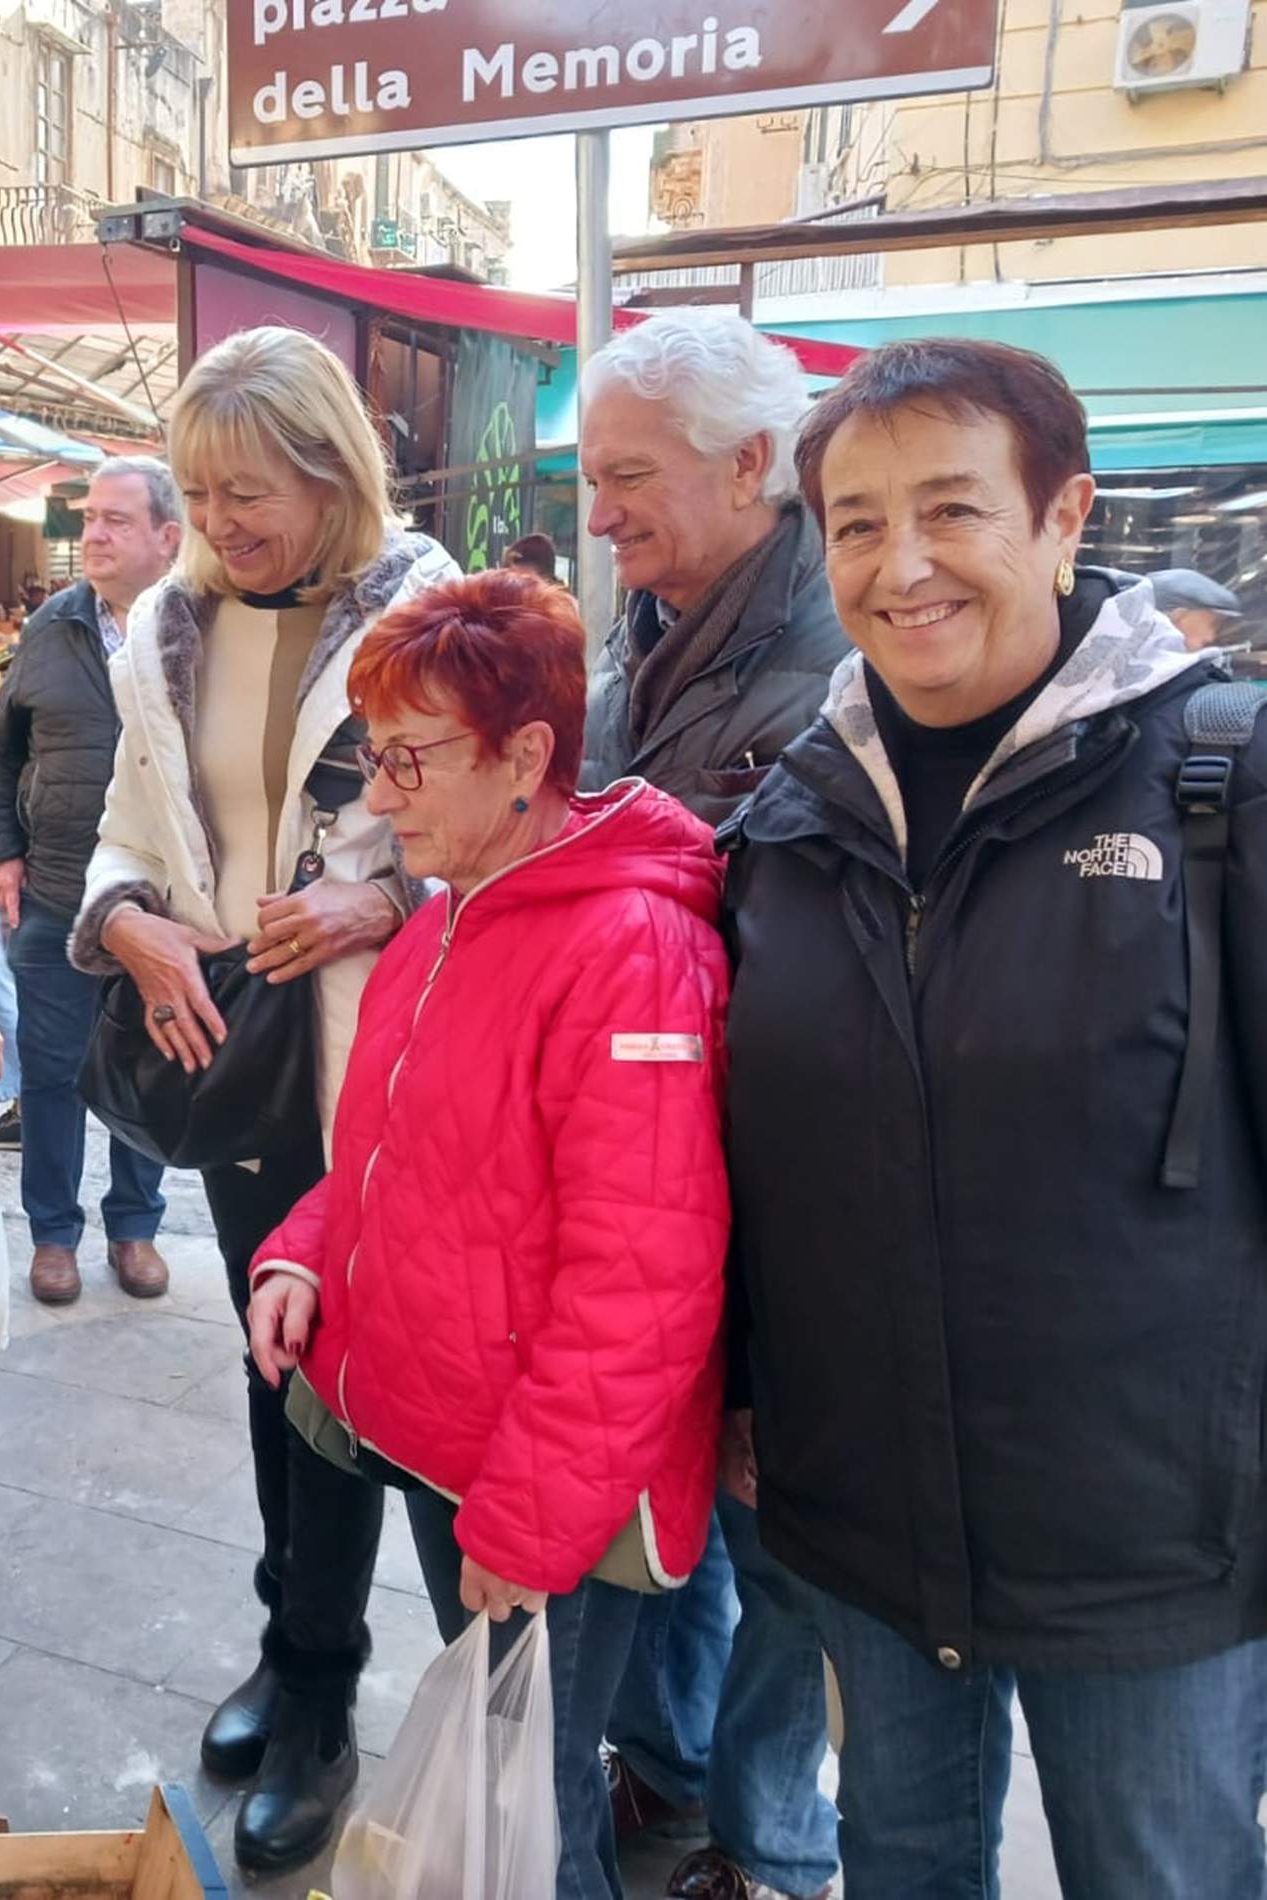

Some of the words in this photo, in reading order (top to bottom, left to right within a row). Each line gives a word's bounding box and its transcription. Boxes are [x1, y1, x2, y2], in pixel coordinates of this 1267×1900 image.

[253, 61, 411, 123] della
[462, 19, 762, 102] Memoria
[1094, 833, 1129, 848] THE
[1063, 848, 1127, 864] NORTH
[1079, 861, 1127, 877] FACE
